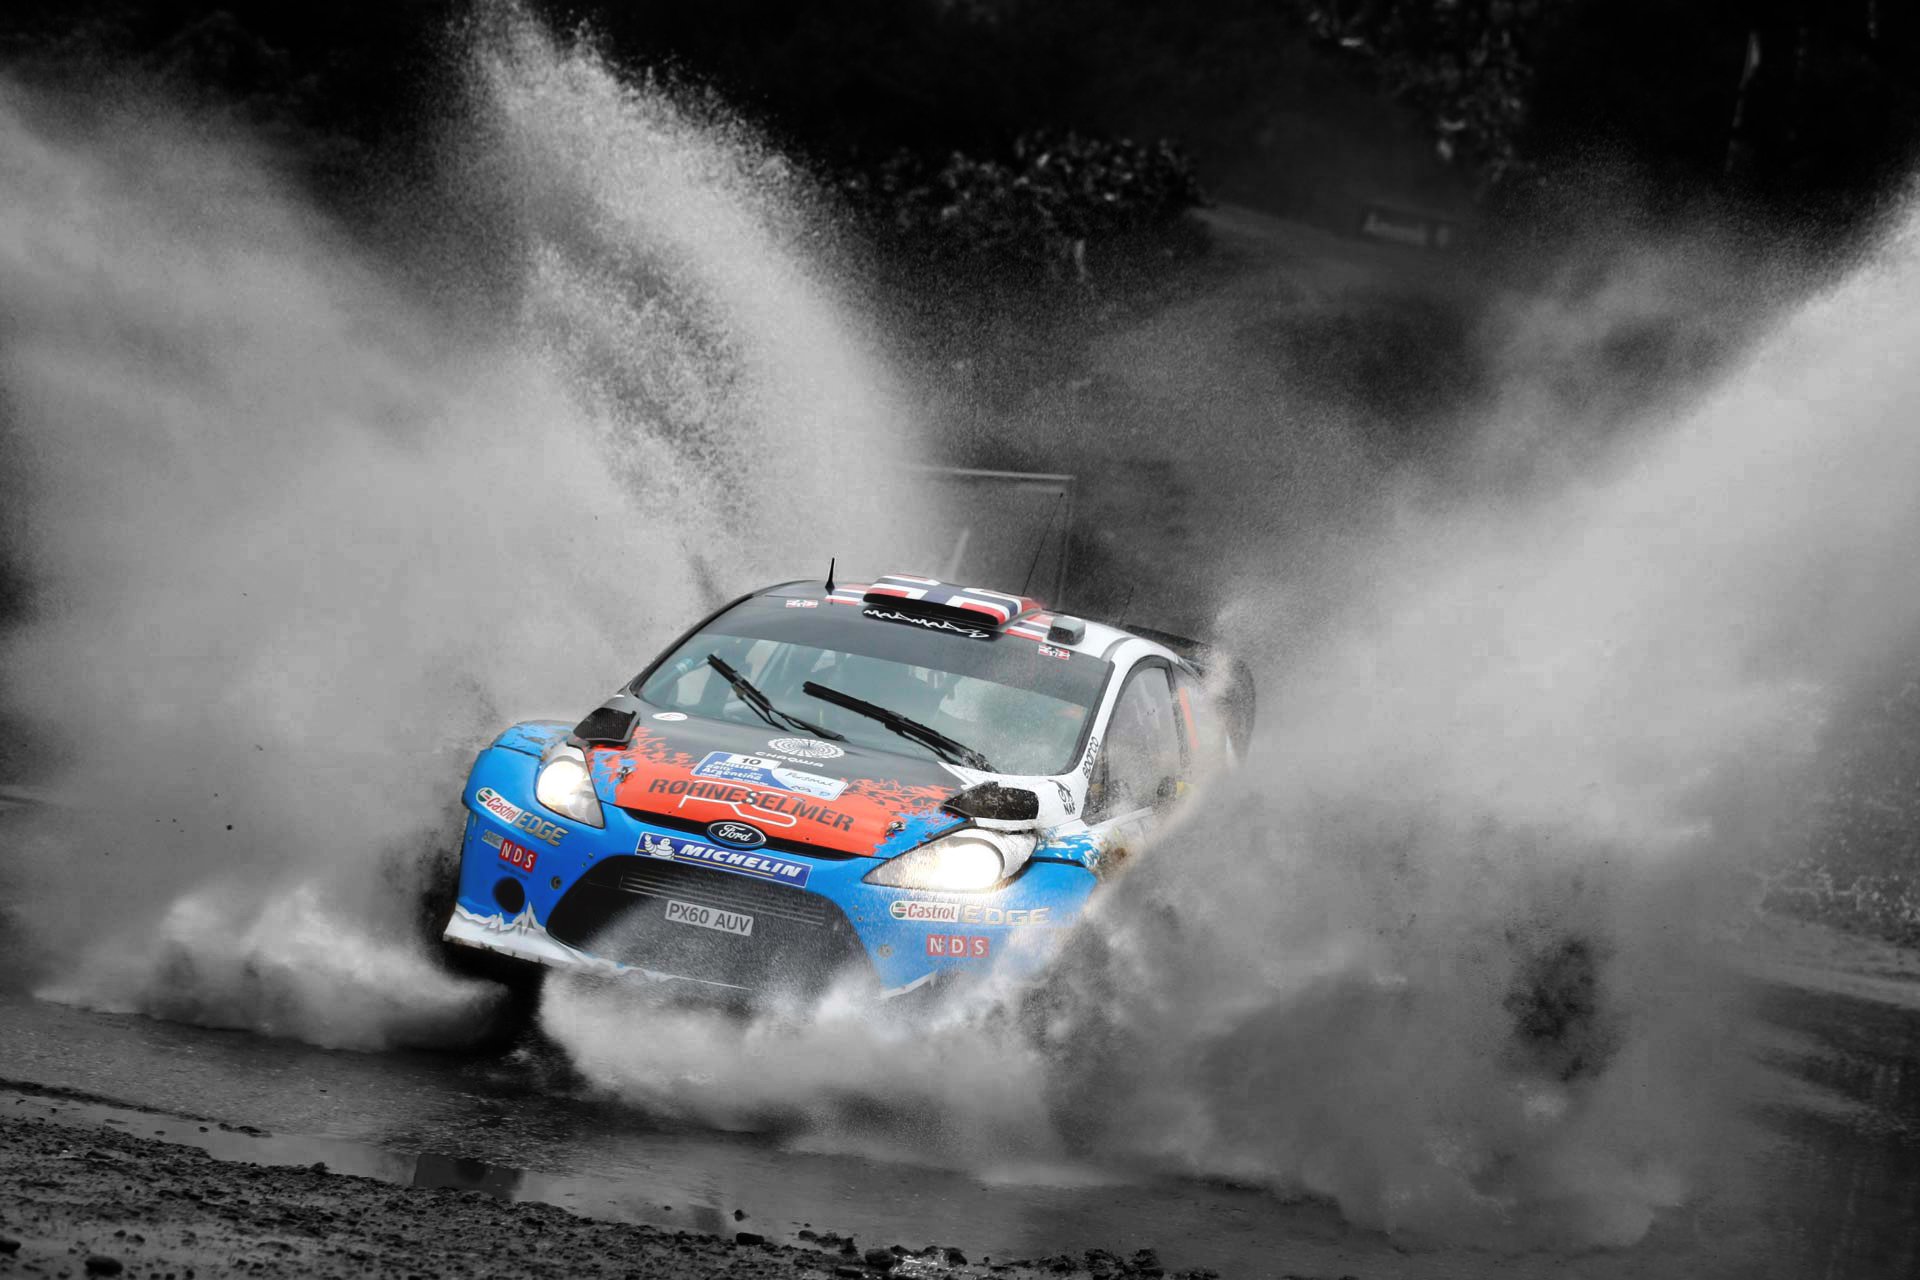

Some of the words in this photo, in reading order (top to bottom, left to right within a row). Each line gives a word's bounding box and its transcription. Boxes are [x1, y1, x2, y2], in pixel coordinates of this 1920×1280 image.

[702, 767, 763, 781] Argentina
[741, 757, 762, 767] 10
[485, 796, 521, 823] Castrol
[513, 811, 569, 846] EDGE
[718, 825, 752, 843] Ford
[679, 843, 802, 878] MICHELIN
[668, 903, 710, 925] PX60
[714, 912, 751, 933] AUV
[907, 902, 956, 921] Castrol
[962, 905, 1050, 926] EDGE
